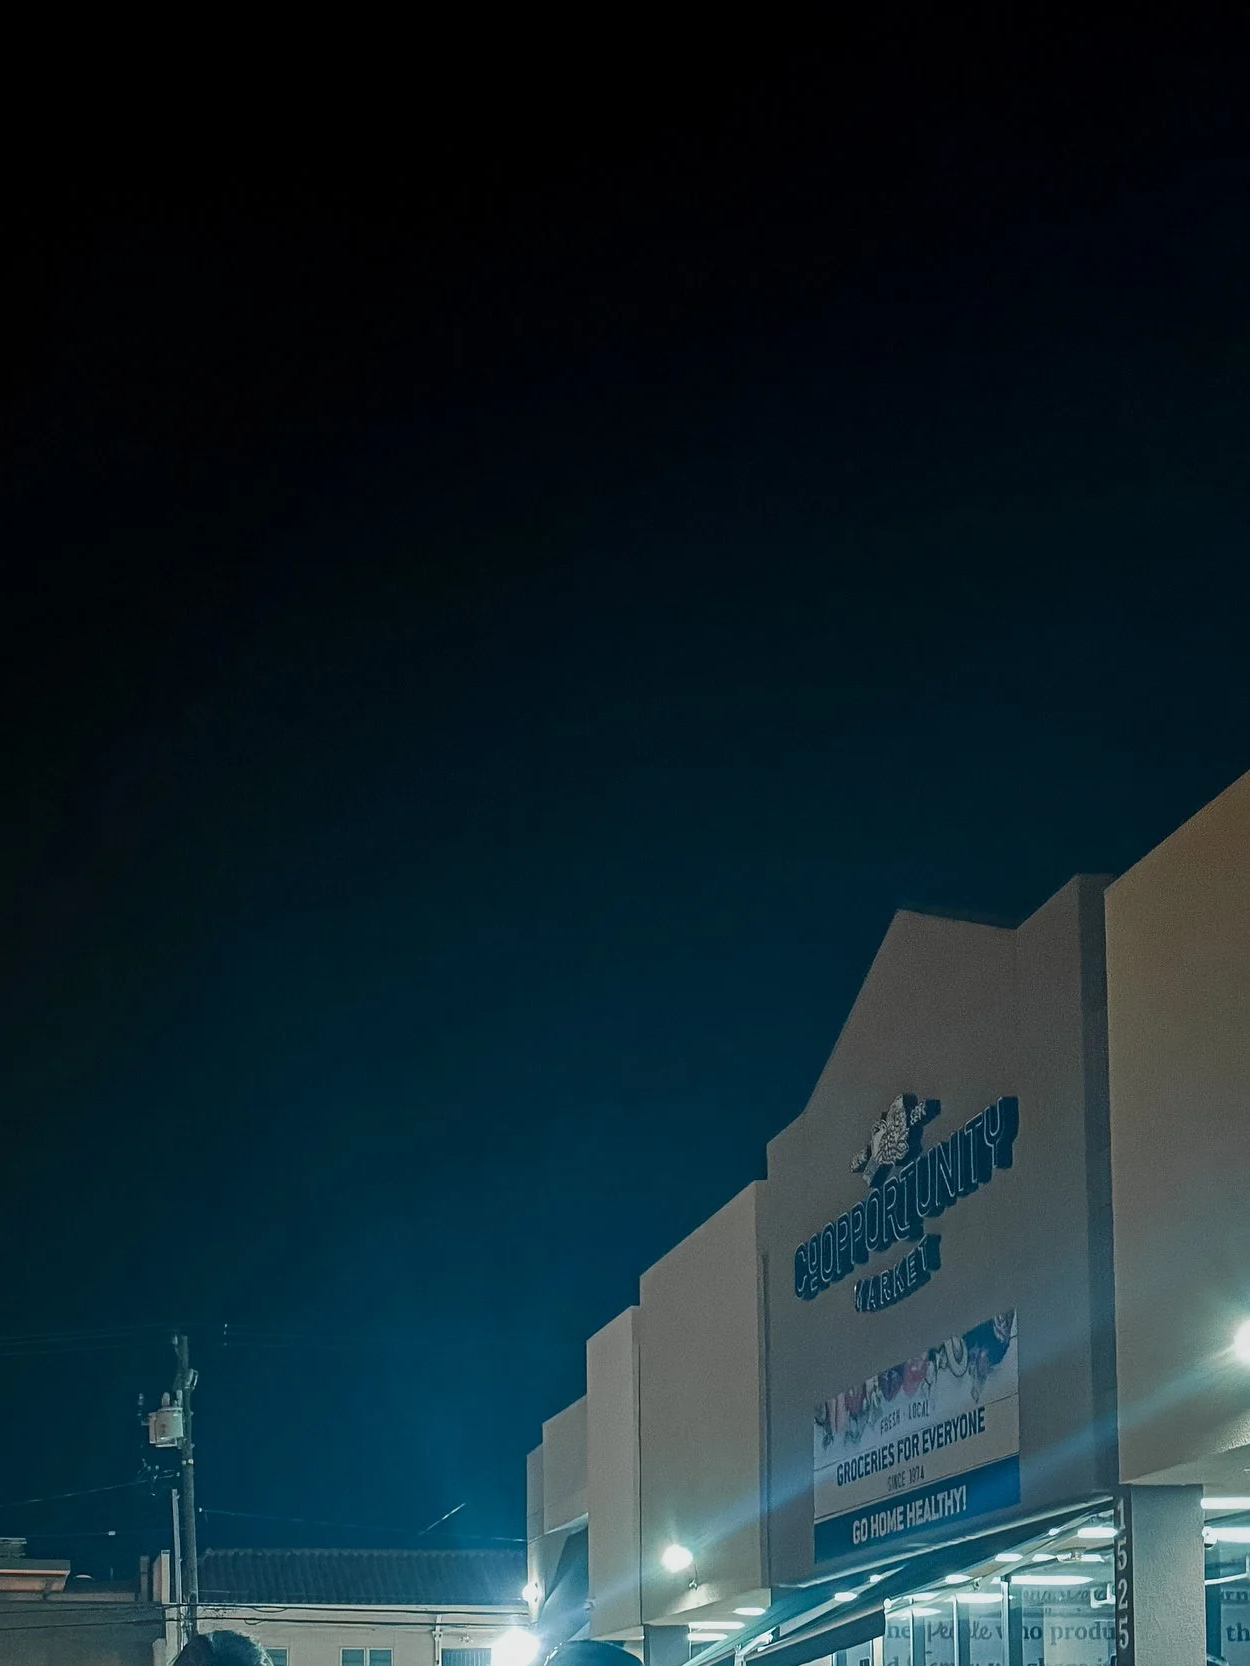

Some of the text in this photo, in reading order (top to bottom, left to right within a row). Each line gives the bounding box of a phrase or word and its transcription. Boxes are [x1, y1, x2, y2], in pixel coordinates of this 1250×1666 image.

[854, 1234, 937, 1311] MARKET
[908, 1400, 930, 1420] LOCAL
[837, 1407, 986, 1486] GROCERIES FOR EVERYONE
[853, 1485, 967, 1545] GO HOME HEALTHY!
[887, 1470, 906, 1492] SINCE
[1116, 1499, 1131, 1650] 1525
